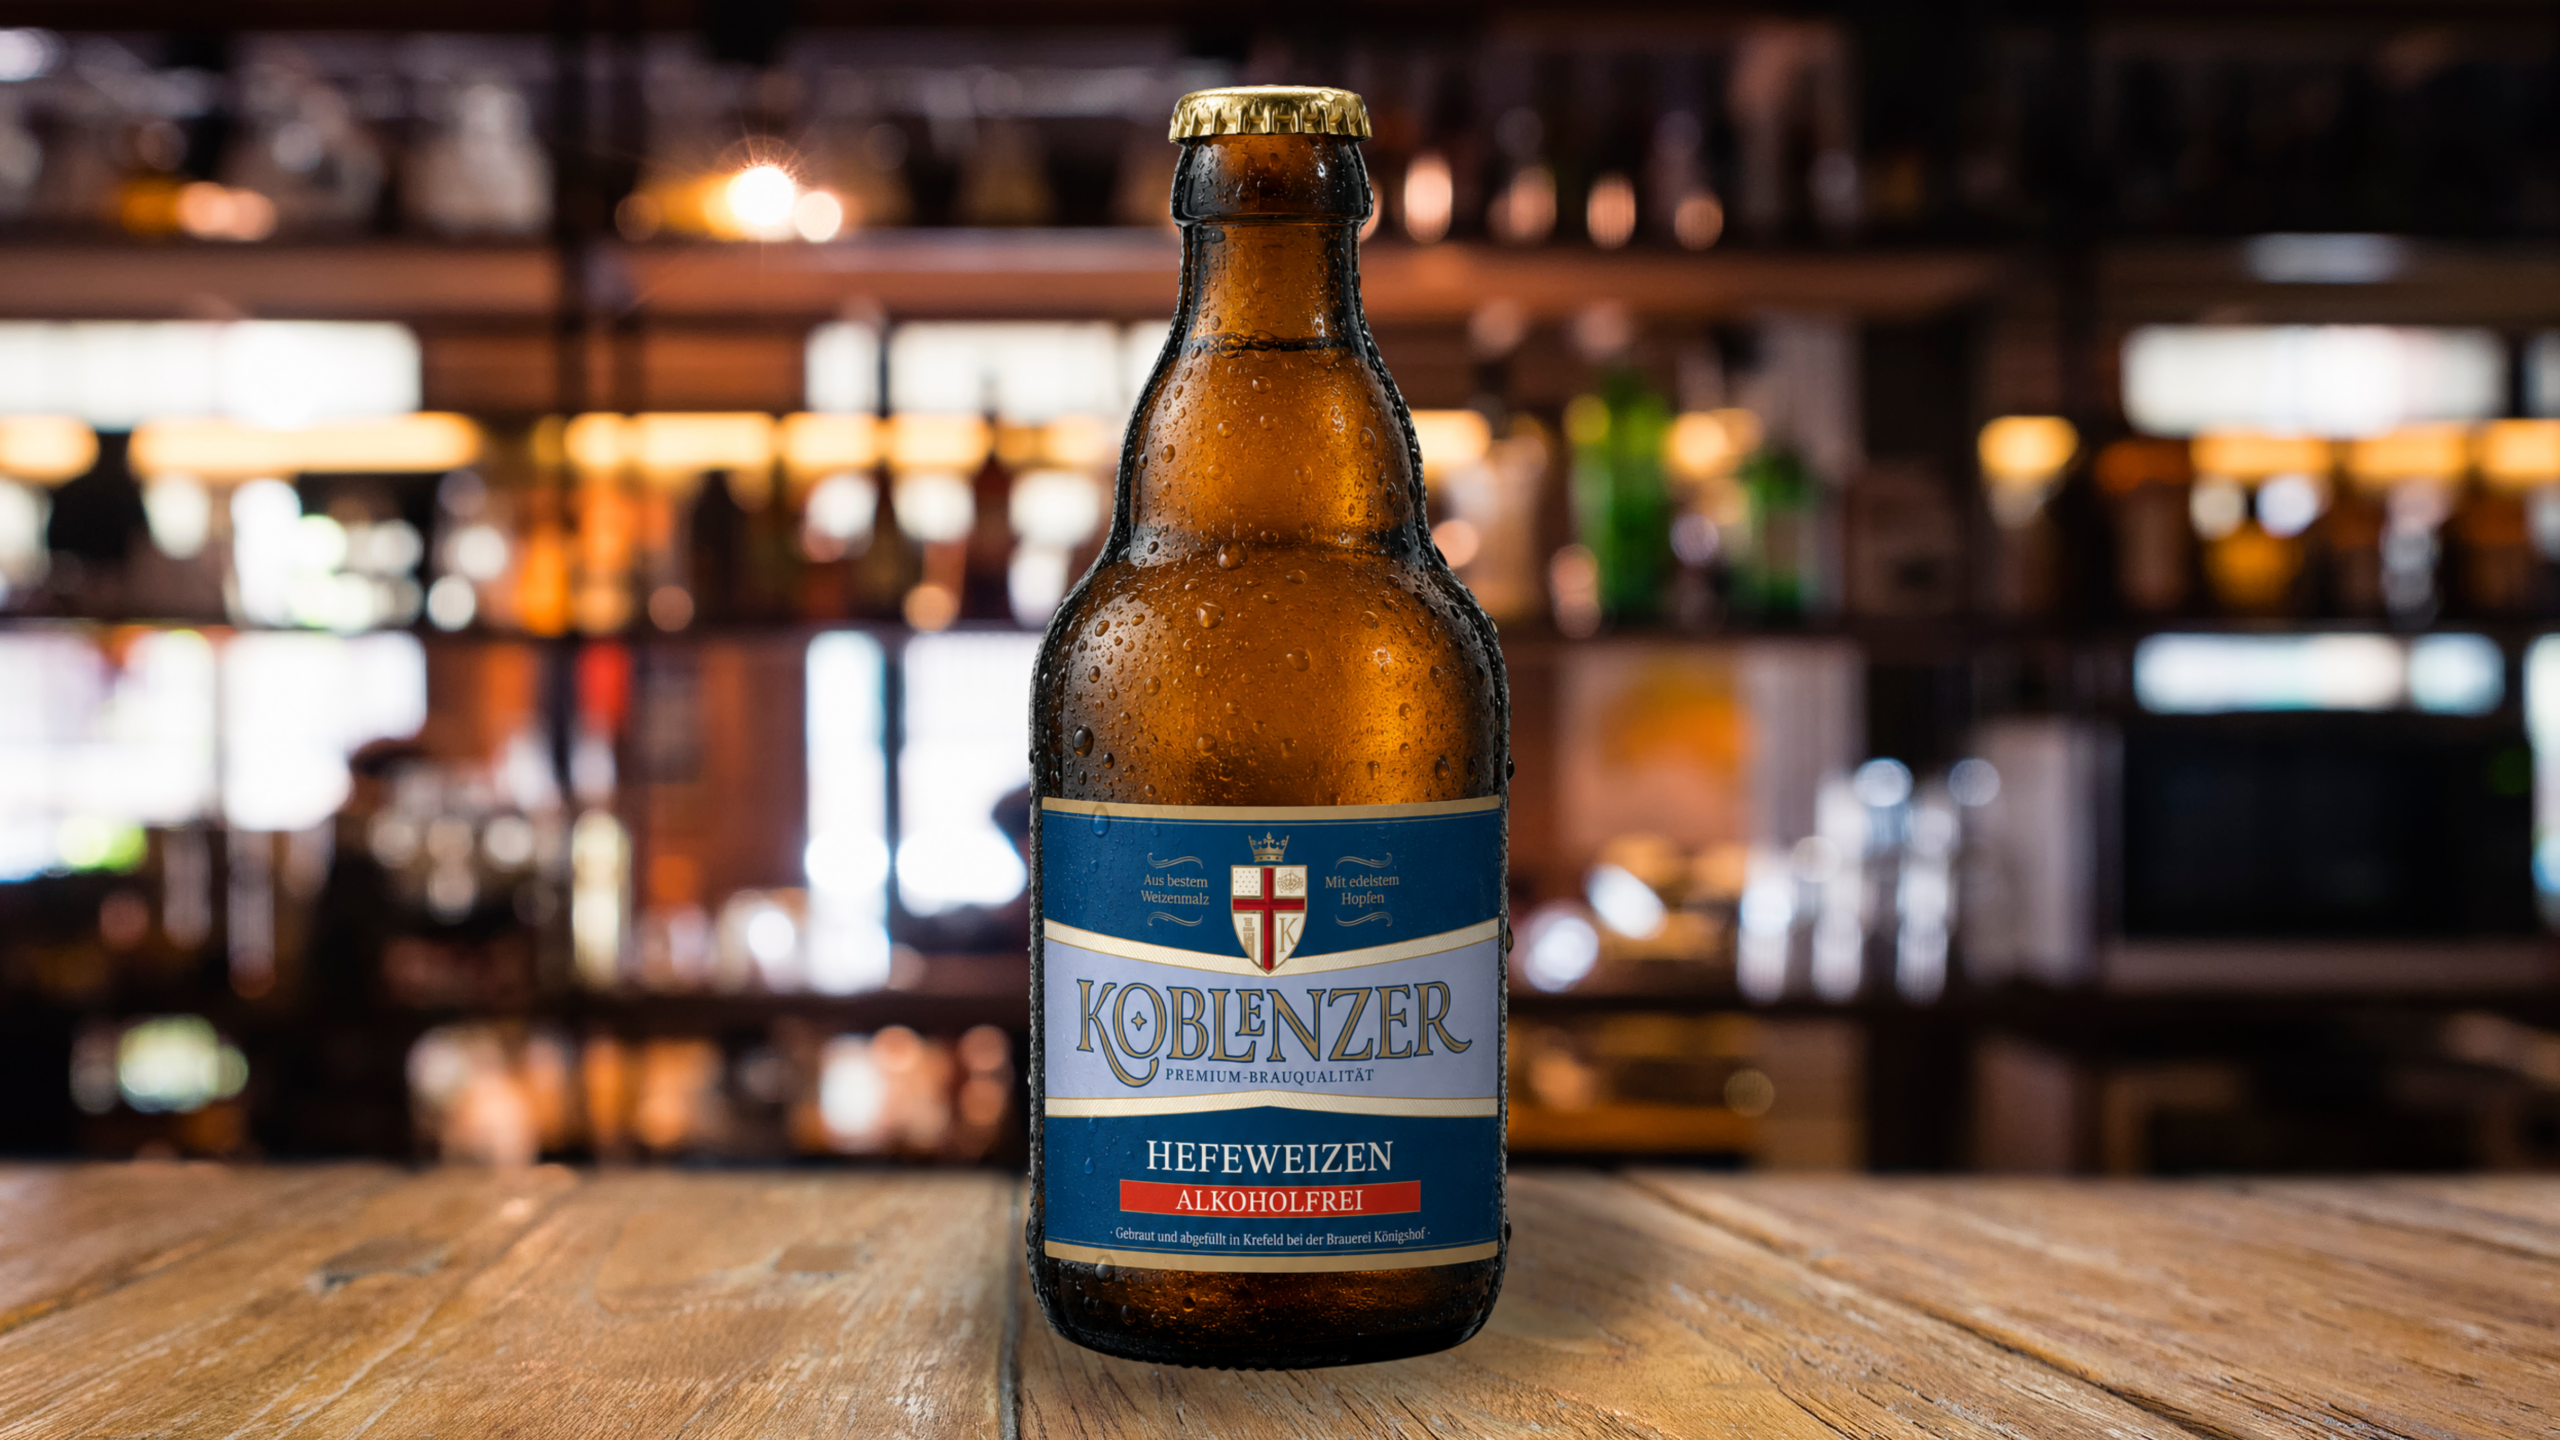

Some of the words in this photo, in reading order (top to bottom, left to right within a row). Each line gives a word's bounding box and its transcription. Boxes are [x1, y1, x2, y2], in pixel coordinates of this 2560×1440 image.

[1143, 874, 1165, 888] Aus
[1166, 874, 1209, 889] bestem
[1325, 875, 1346, 889] Mit
[1349, 874, 1400, 888] edelstem
[1141, 890, 1210, 905] Weizenmalz
[1341, 892, 1385, 907] Hopfen
[1279, 917, 1299, 953] K
[1076, 979, 1473, 1088] KOBLENZER
[1165, 1067, 1375, 1086] PREMIUM-BRAUQUALITÄT
[1146, 1140, 1394, 1174] HEFEWEIZEN
[1175, 1189, 1364, 1212] ALKOHOLFREI
[1115, 1227, 1155, 1242] Gebraut
[1157, 1230, 1178, 1244] und
[1180, 1230, 1227, 1247] abgefüllt
[1229, 1232, 1241, 1246] in
[1243, 1232, 1284, 1247] Krefeld
[1287, 1231, 1303, 1246] bei
[1305, 1231, 1324, 1246] der
[1327, 1230, 1371, 1245] Brauerei
[1374, 1226, 1425, 1245] Königshof
